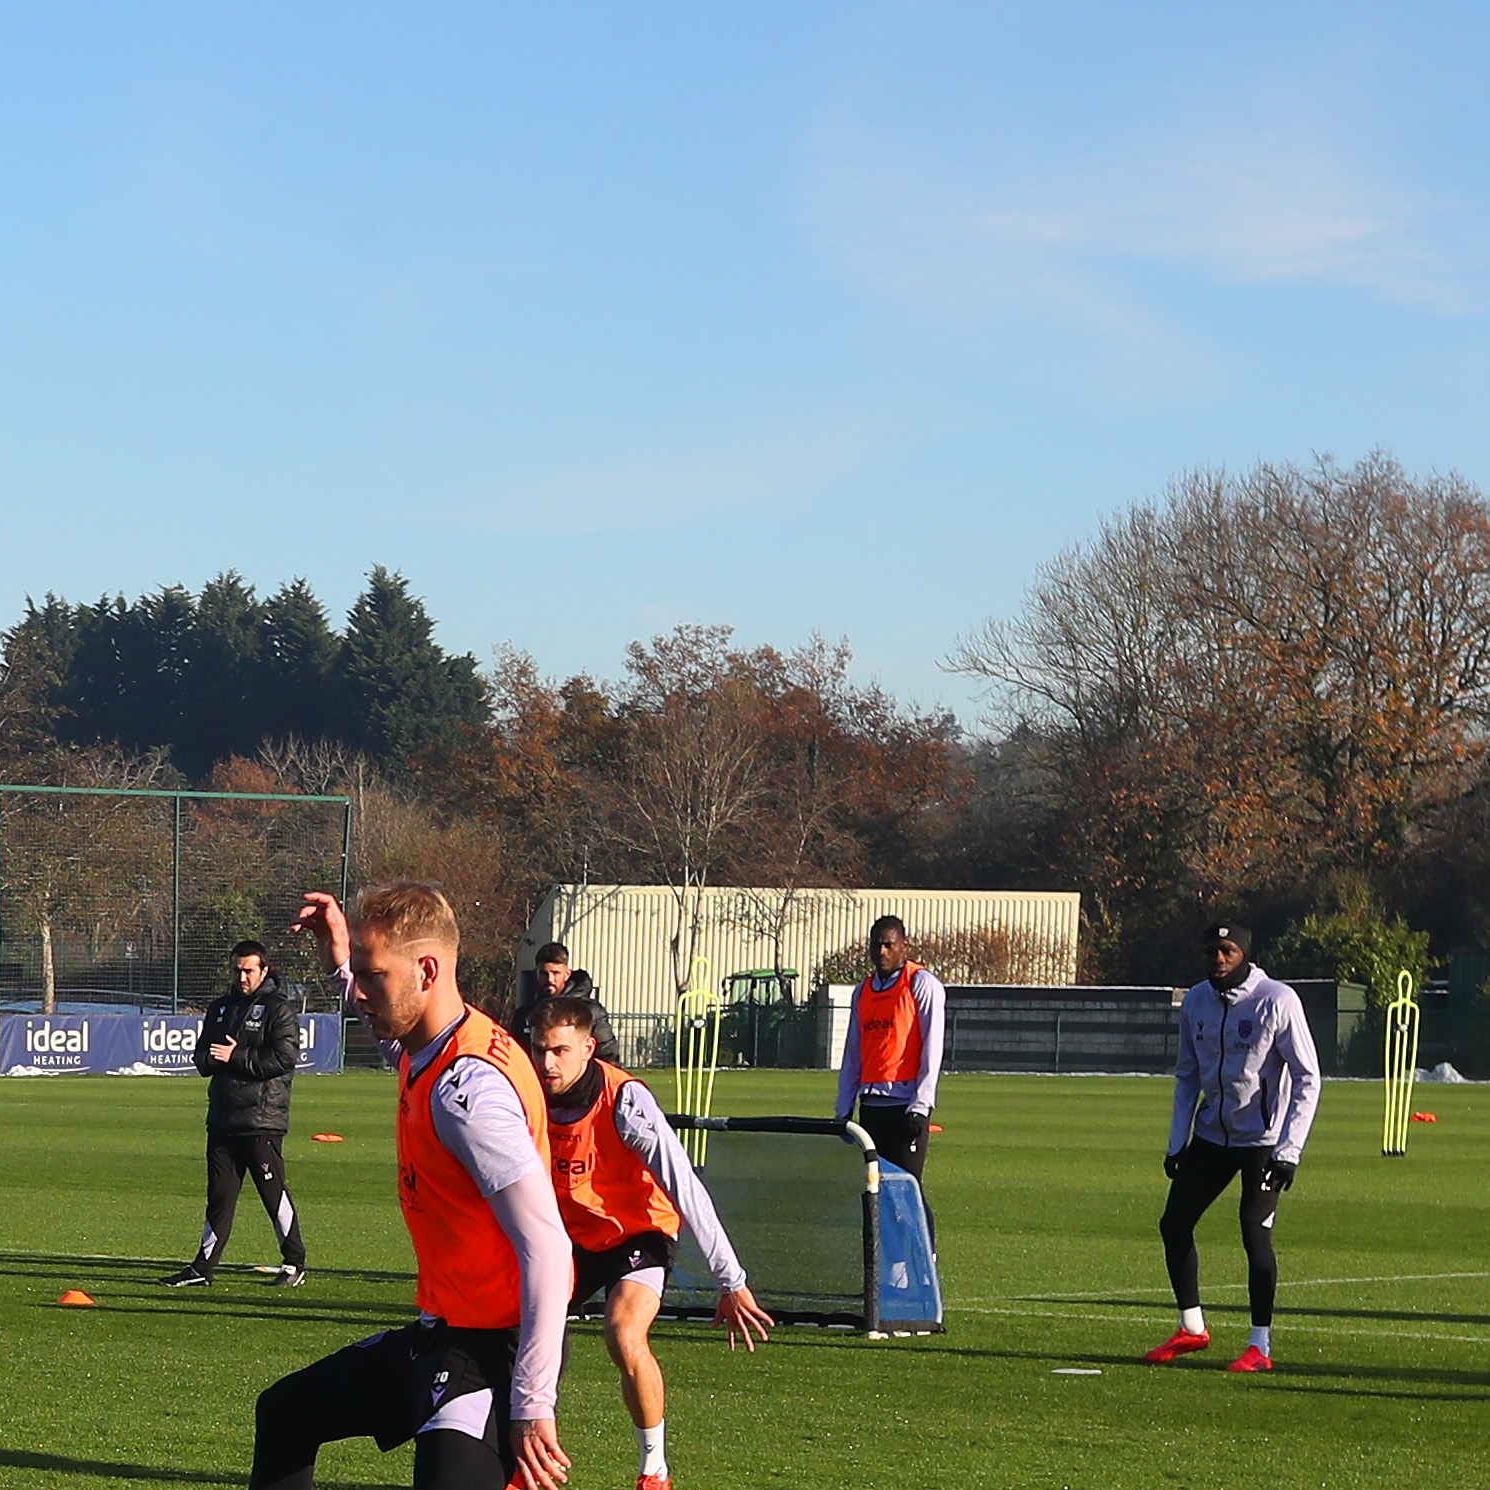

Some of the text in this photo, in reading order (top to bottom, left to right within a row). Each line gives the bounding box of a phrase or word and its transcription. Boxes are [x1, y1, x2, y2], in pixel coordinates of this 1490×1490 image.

[27, 1020, 89, 1052] ideal
[142, 1020, 204, 1051] ideal
[33, 1055, 81, 1065] HEATING
[433, 1371, 449, 1384] 20
